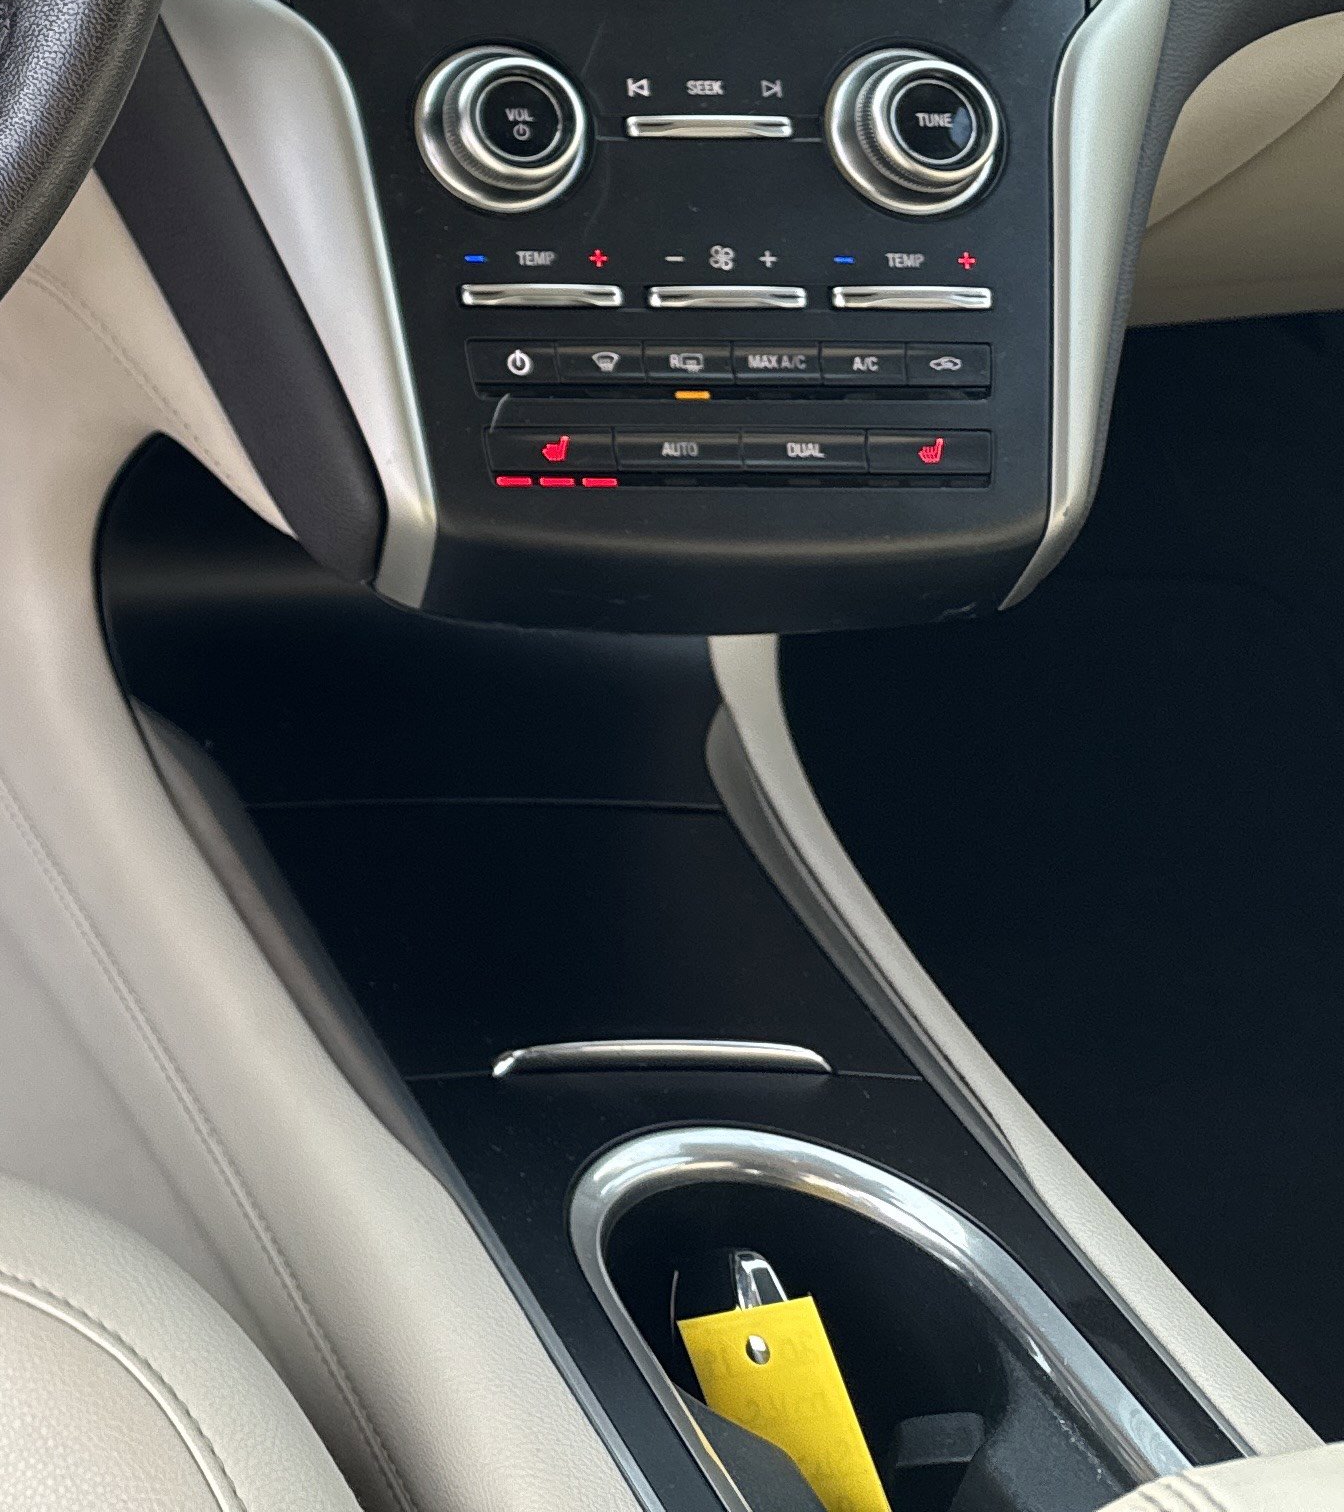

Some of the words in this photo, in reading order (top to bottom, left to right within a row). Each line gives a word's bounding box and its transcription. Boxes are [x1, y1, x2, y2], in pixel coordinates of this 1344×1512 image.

[687, 80, 723, 96] SEEK
[505, 107, 534, 124] VOL
[916, 113, 953, 128] TUNE
[516, 251, 556, 266] TEMP
[885, 253, 924, 268] TEMP
[747, 354, 778, 369] MAX
[780, 355, 806, 369] A/C
[852, 356, 879, 371] A/C
[662, 441, 699, 457] AUTO
[786, 442, 825, 458] DUAL
